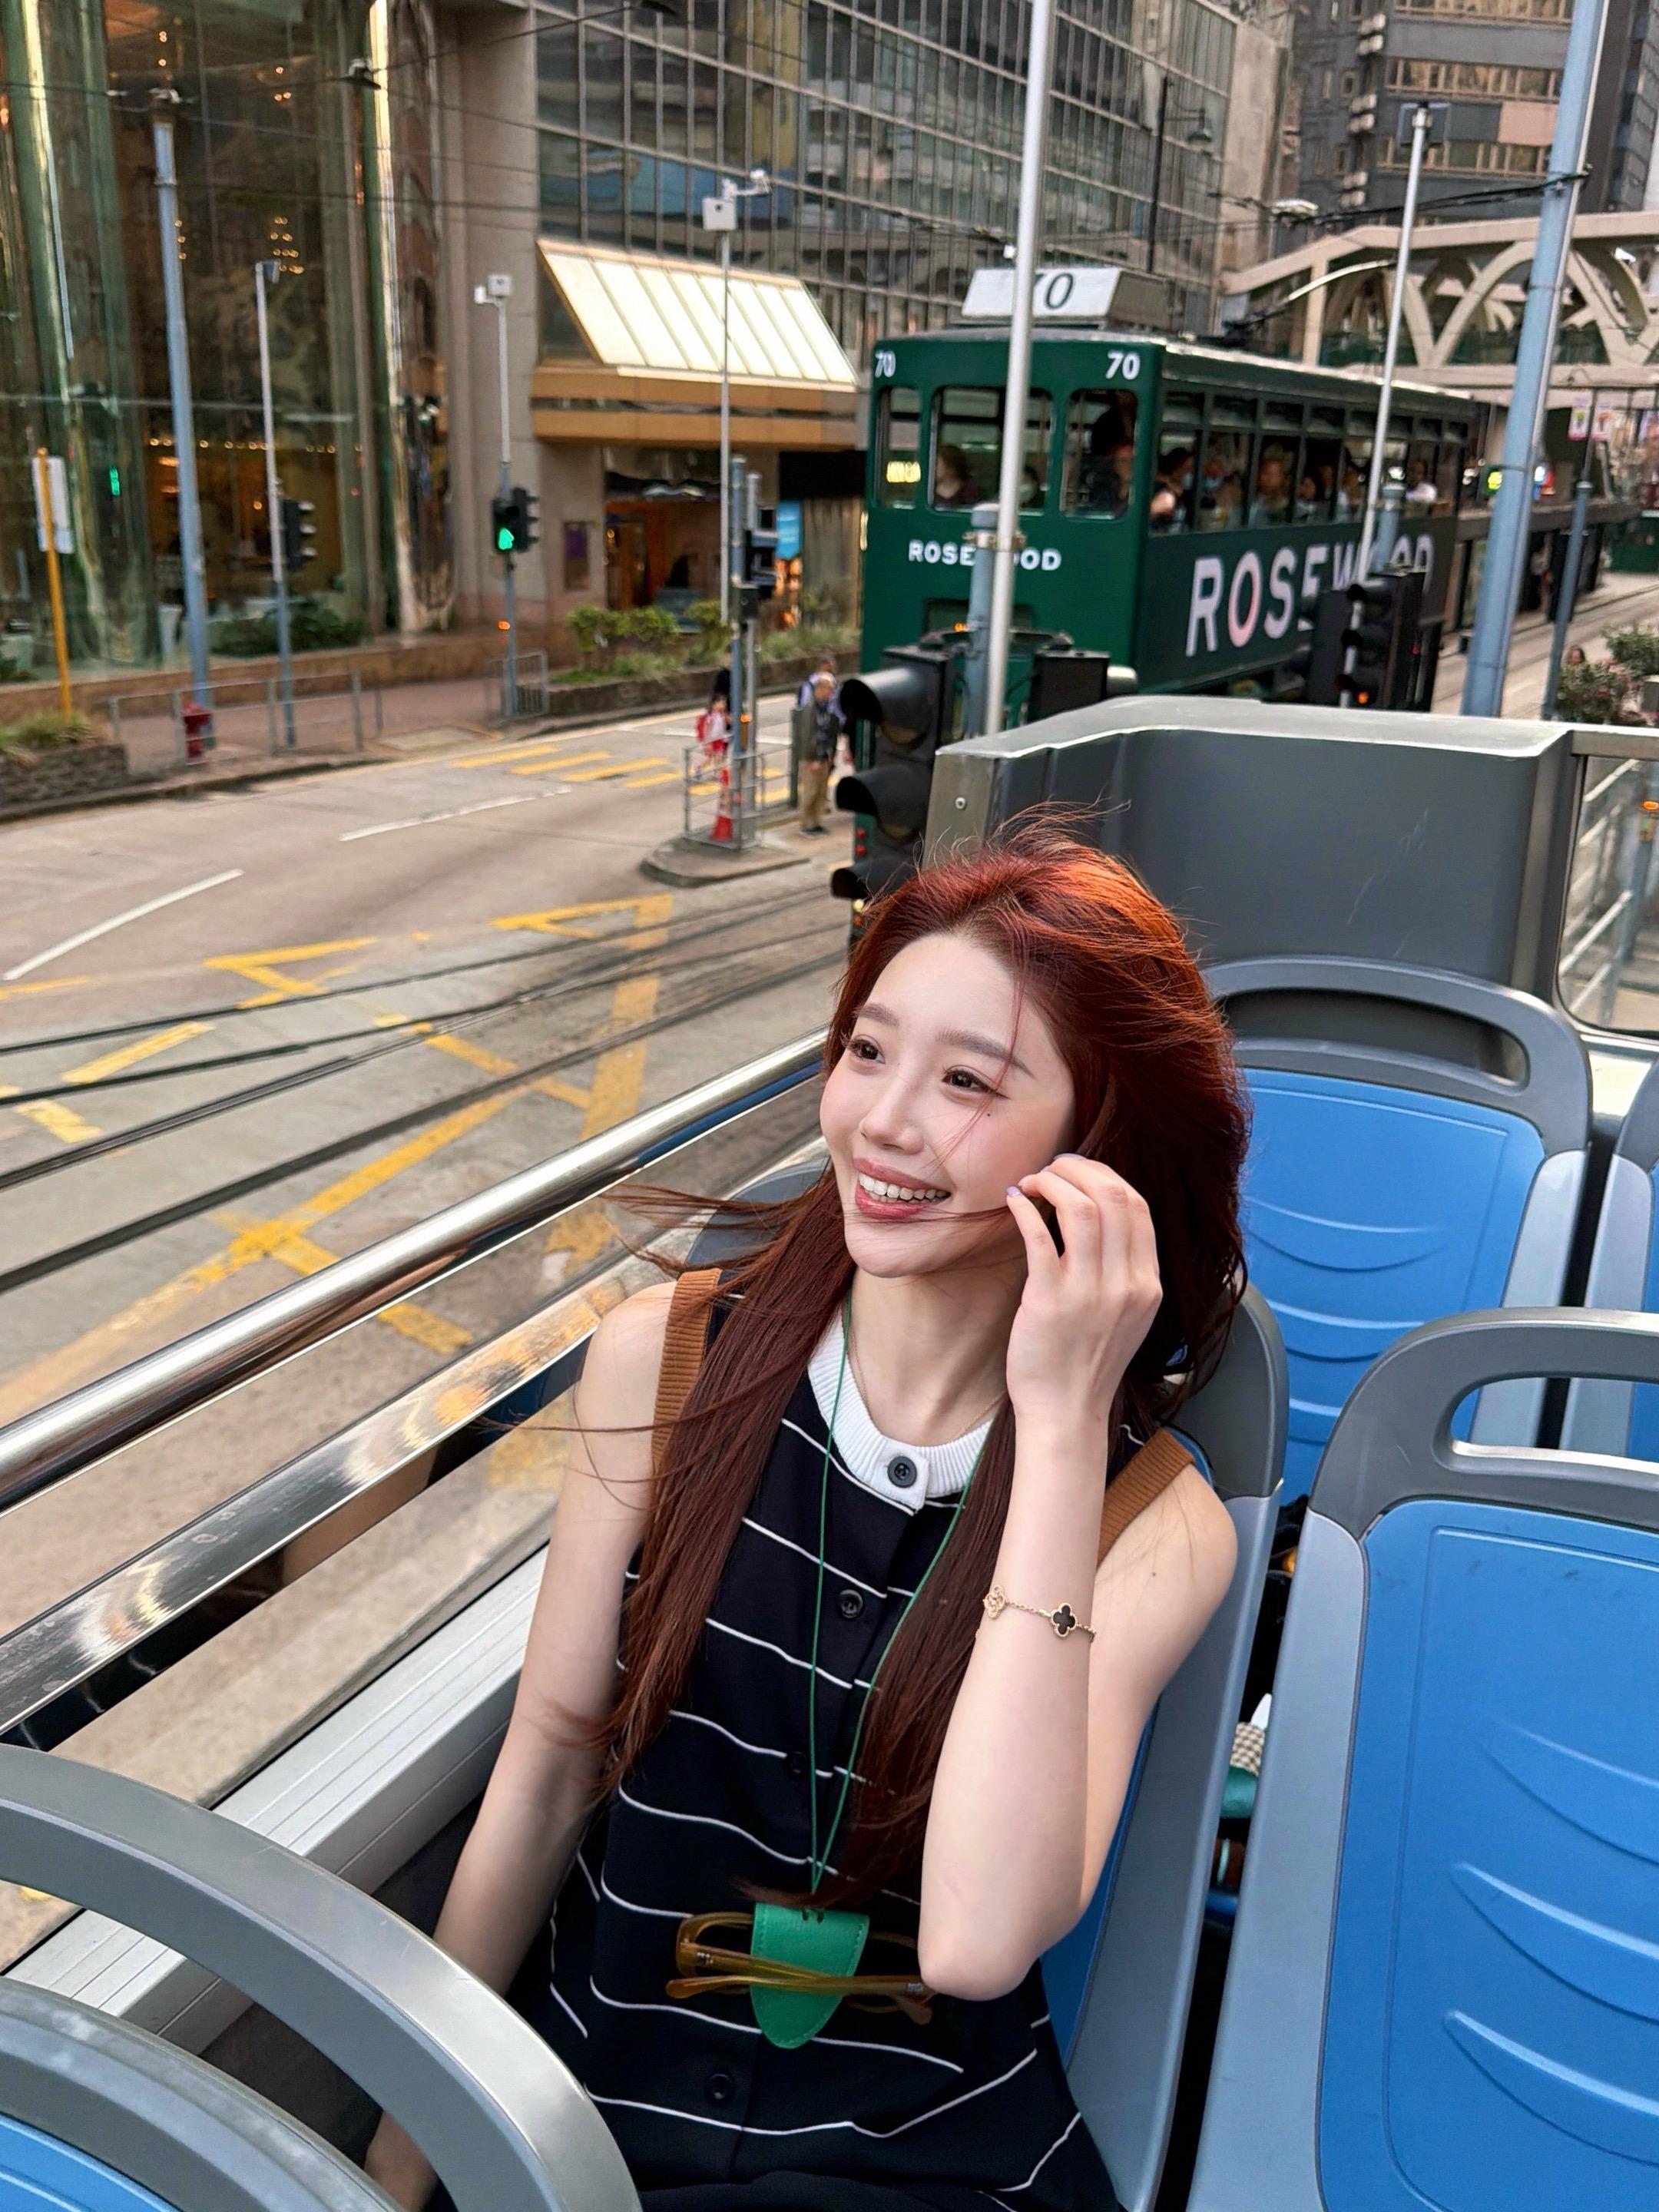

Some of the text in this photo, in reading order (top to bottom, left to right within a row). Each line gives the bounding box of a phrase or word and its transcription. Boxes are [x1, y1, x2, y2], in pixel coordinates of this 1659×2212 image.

[875, 350, 896, 378] 70
[1106, 350, 1141, 380] 70
[908, 538, 1062, 571] ROSEOD
